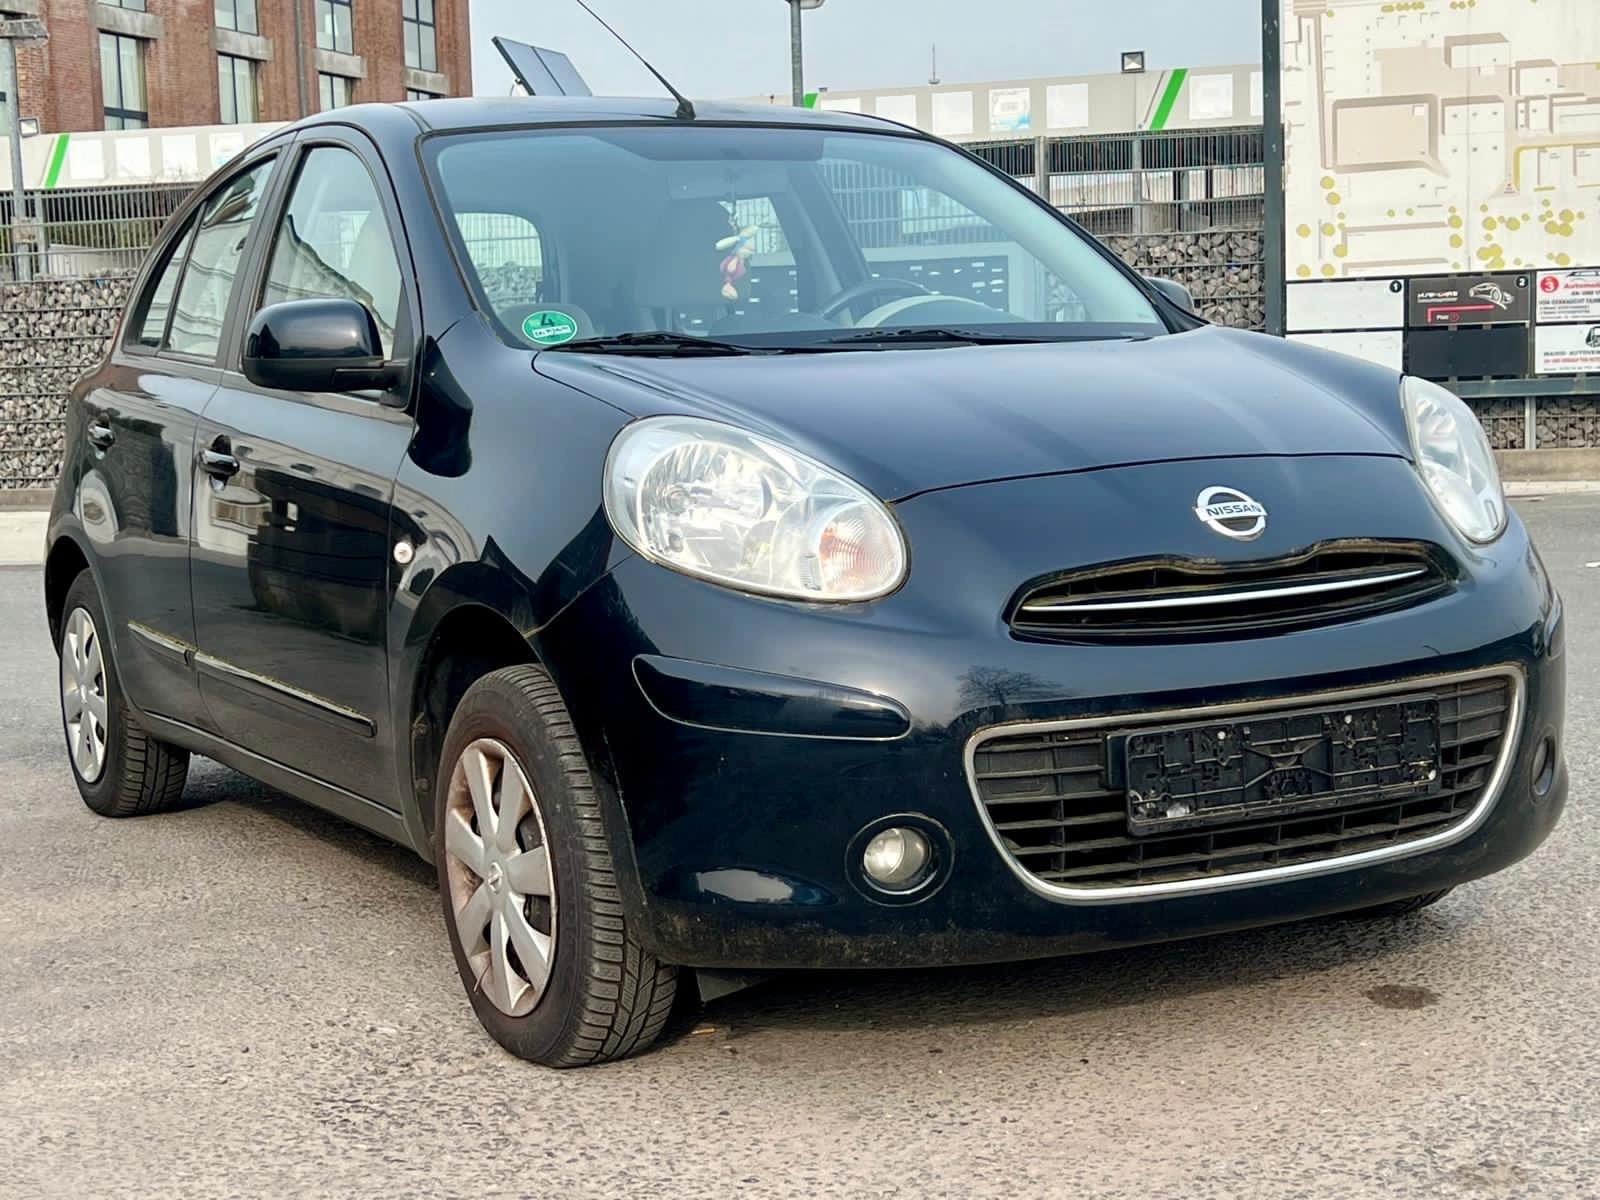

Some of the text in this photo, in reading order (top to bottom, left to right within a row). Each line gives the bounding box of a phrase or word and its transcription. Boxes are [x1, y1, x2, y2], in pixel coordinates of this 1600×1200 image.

[1543, 276, 1556, 291] 3
[541, 313, 555, 327] 4
[1205, 504, 1262, 517] NISSAN
